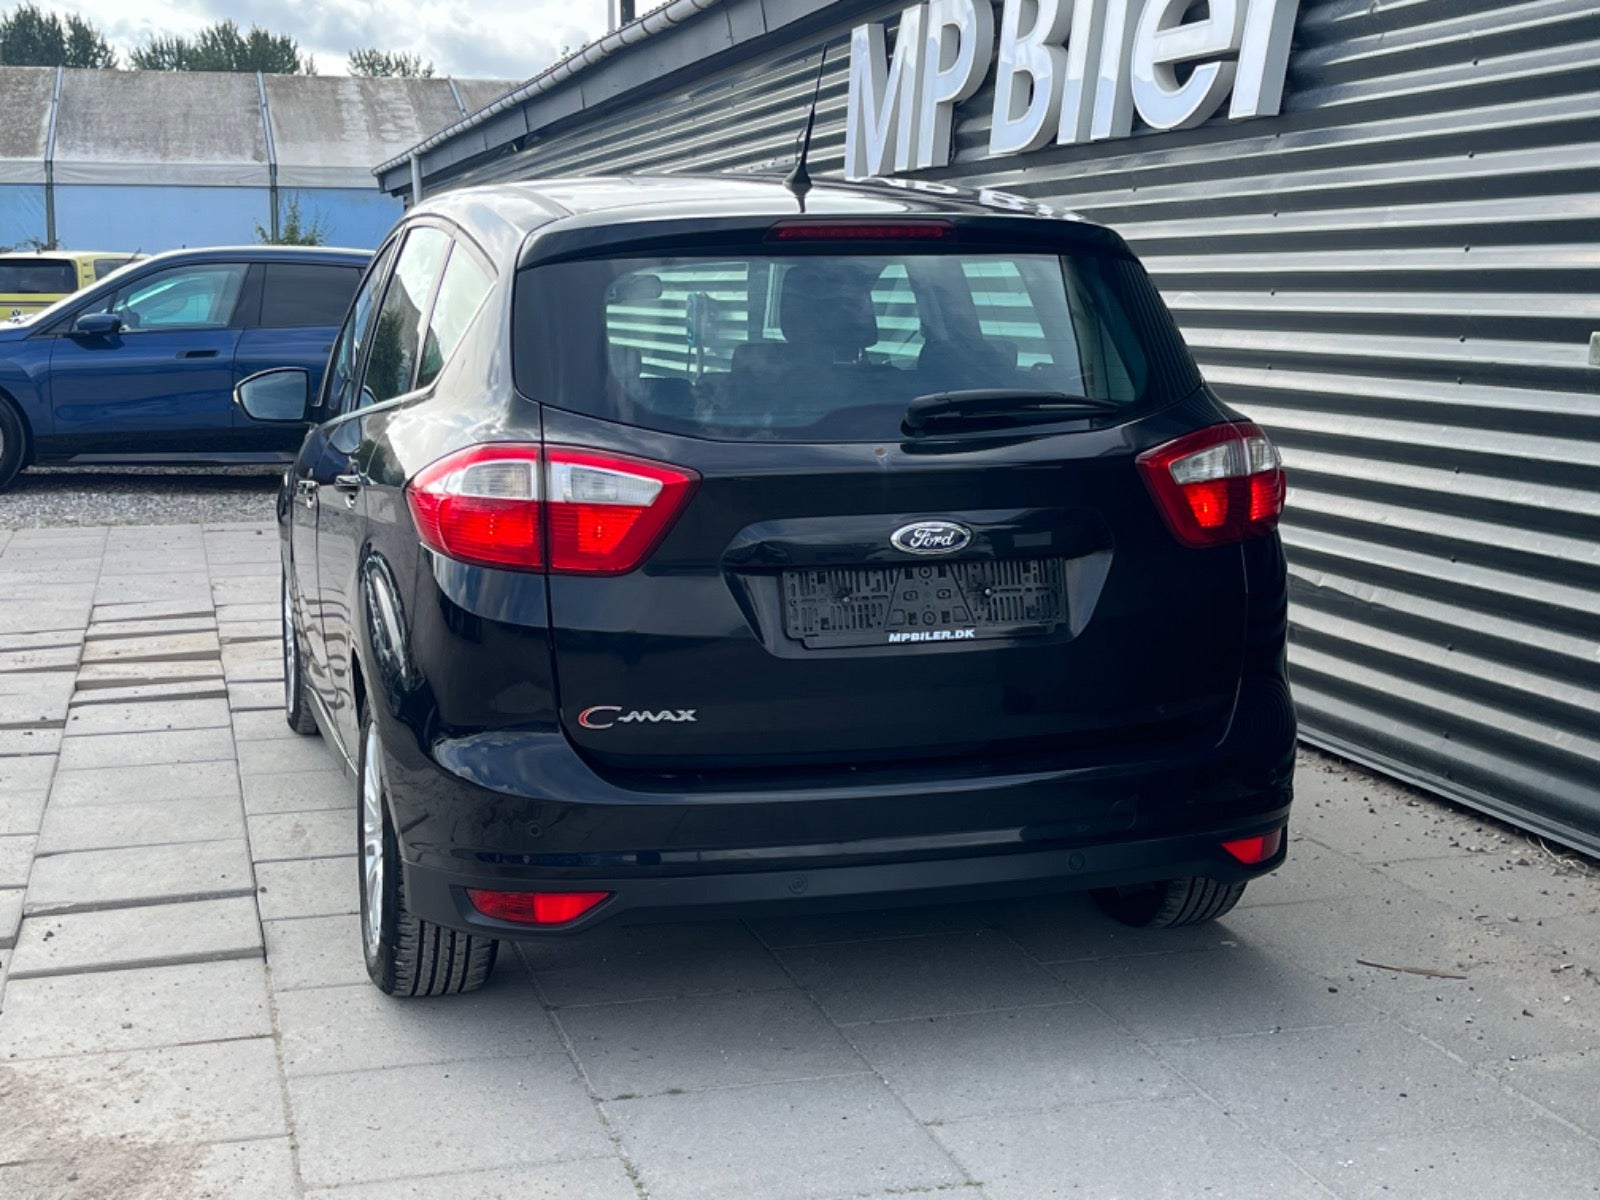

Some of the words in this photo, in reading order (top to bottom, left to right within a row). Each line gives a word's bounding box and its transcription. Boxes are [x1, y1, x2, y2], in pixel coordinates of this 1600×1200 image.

[910, 528, 955, 547] Ford
[888, 629, 976, 643] MPBILER.DK
[578, 705, 697, 729] C-MAX
